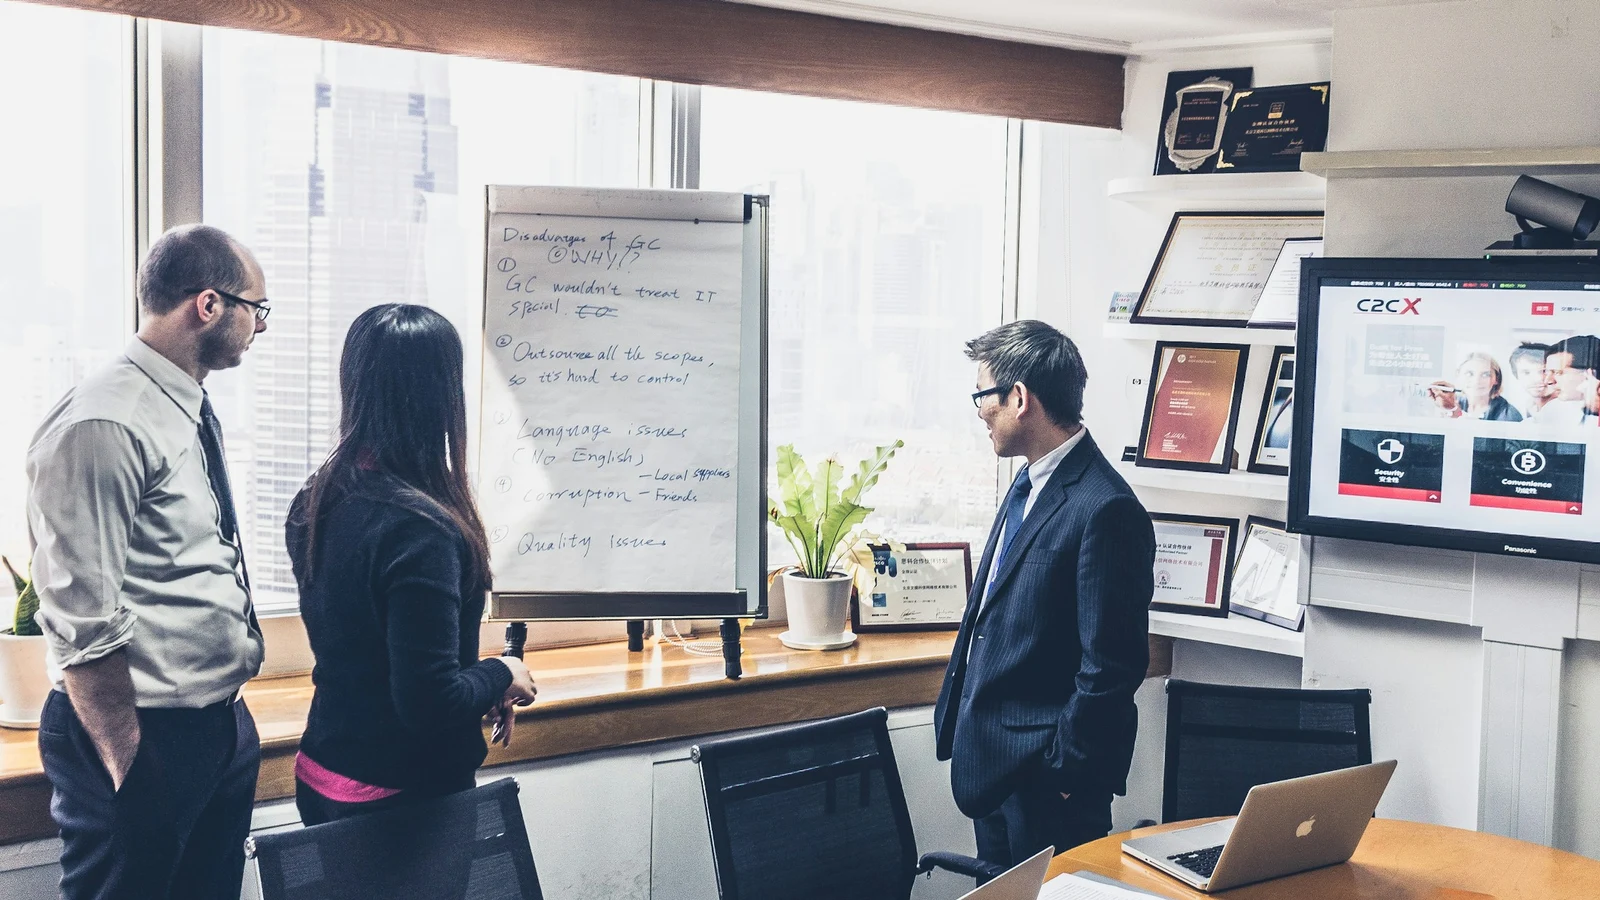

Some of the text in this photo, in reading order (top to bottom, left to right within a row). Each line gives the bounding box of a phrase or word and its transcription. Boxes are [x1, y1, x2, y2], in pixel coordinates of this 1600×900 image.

[600, 231, 617, 250] of
[630, 234, 661, 251] GC
[505, 273, 717, 303] GC wouldn't treat IT
[1355, 297, 1422, 316] C2CX
[597, 344, 618, 361] all
[508, 367, 690, 387] so it's hard to control
[516, 418, 687, 447] Language issues
[512, 447, 556, 466] (No
[654, 469, 688, 482] Local
[692, 468, 731, 482] suppliers
[1374, 468, 1405, 478] Security
[1501, 478, 1553, 489] Convenience
[655, 489, 698, 502] Friends
[517, 531, 592, 558] Quality
[1503, 544, 1538, 555] Panasonic
[1155, 558, 1204, 567] 信网络技术有限公司
